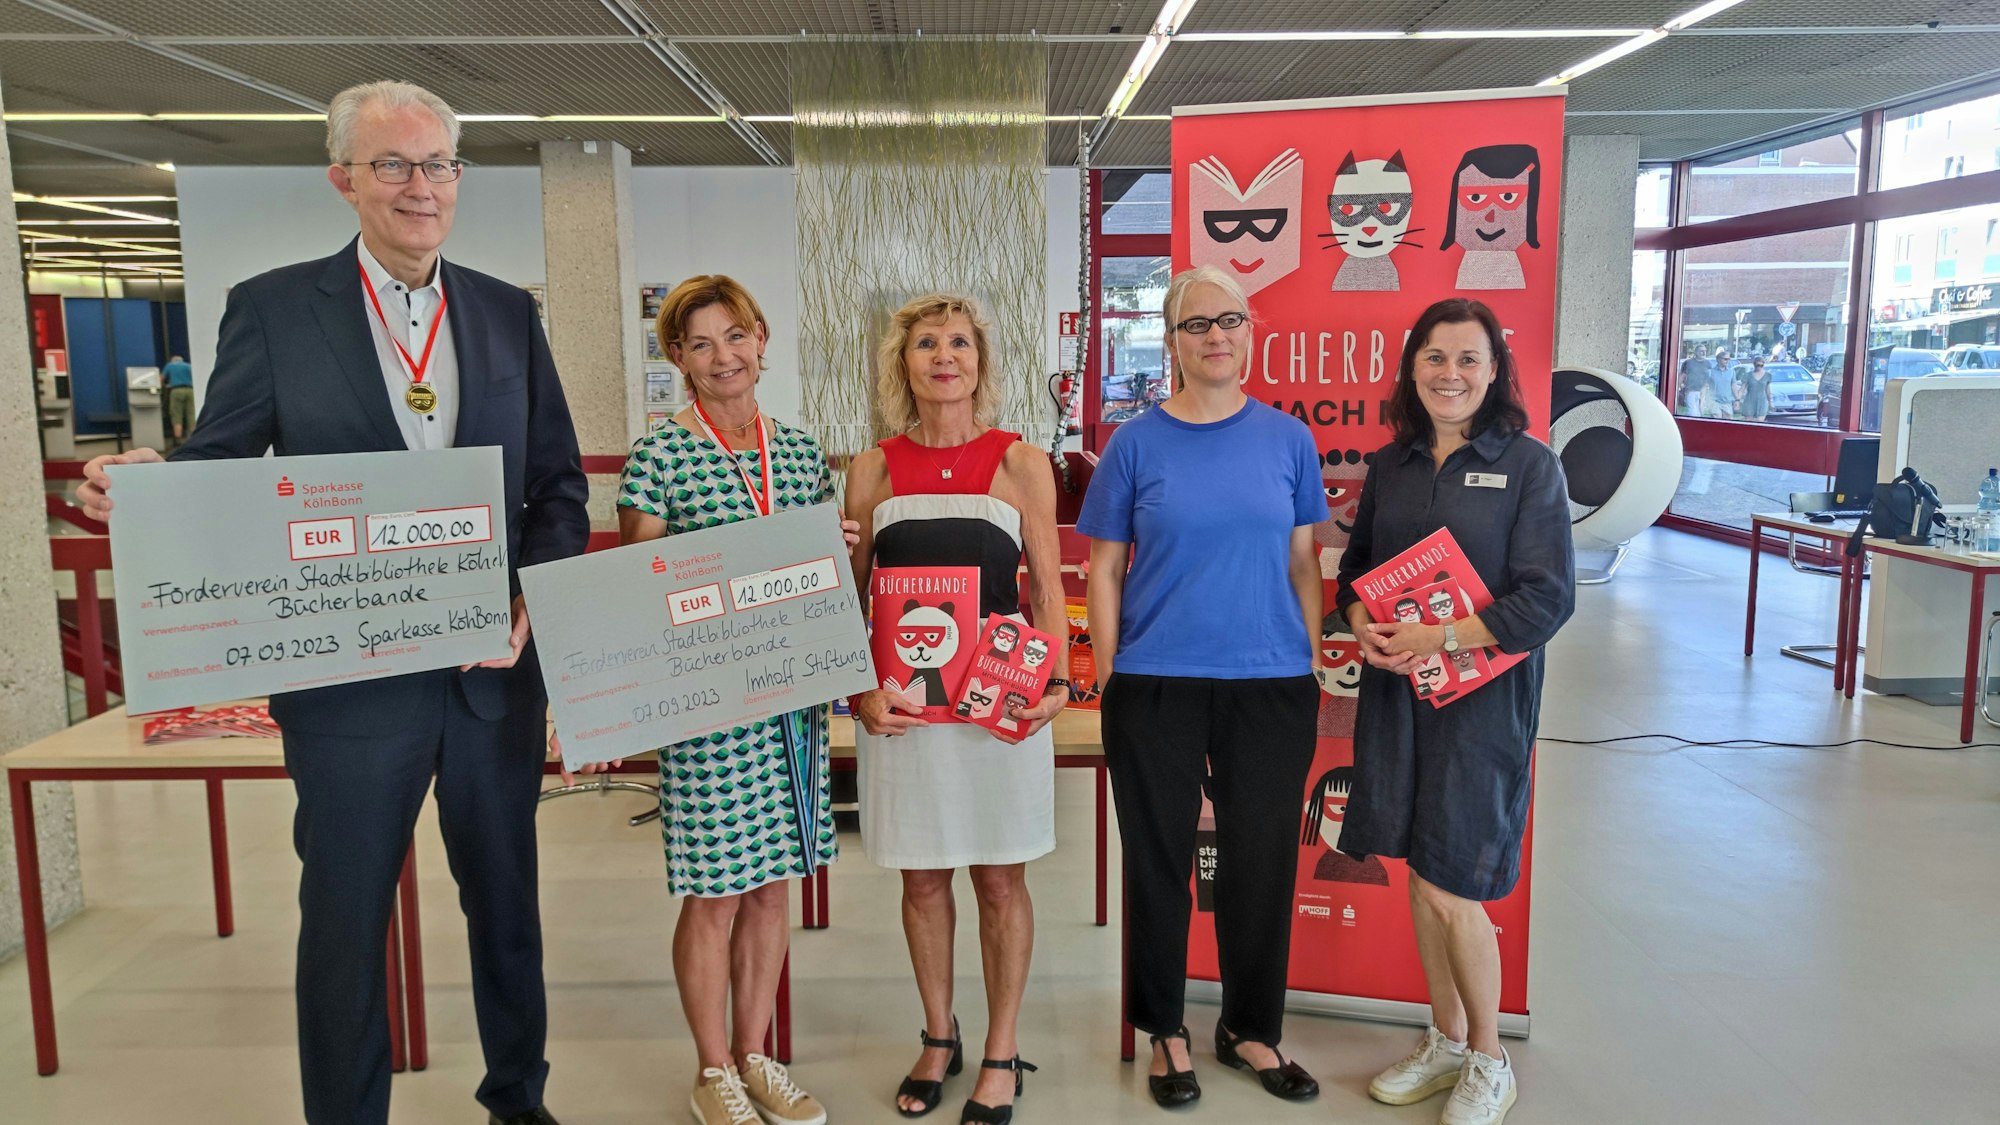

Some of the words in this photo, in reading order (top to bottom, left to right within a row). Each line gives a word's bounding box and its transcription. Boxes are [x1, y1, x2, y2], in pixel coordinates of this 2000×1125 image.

[1966, 285, 1993, 307] Coffee
[302, 481, 364, 496] Sparkasse
[303, 496, 363, 509] KölnBonn
[304, 529, 342, 546] EUR
[370, 520, 474, 547] 12.000,00
[671, 552, 722, 569] Sparkasse
[674, 564, 724, 582] KölnBonn
[1363, 542, 1451, 601] BÜCHERBANDE
[148, 574, 288, 609] Förderverein
[296, 556, 449, 591] Stadtbibliothek
[738, 572, 819, 605] 12.000,00
[879, 574, 968, 595] BÜCHERBANDE
[140, 601, 153, 609] an
[267, 583, 429, 619] Bücherbande
[680, 595, 712, 613] EUR
[142, 618, 240, 637] Verwendungszweck
[358, 619, 443, 657] Sparkasse
[226, 634, 340, 666] 07.09.2023
[406, 644, 422, 653] von
[563, 640, 659, 679] Förderverein
[662, 610, 792, 656] Stadtbibliothek
[666, 634, 792, 678] Bücherbande
[203, 663, 223, 673] den
[745, 657, 796, 693] Imhoff
[802, 648, 868, 676] Stiftung
[976, 654, 1040, 690] BÜCHERBANDE
[566, 680, 641, 705] Verwendungszweck
[633, 688, 721, 723] 07.09.2023
